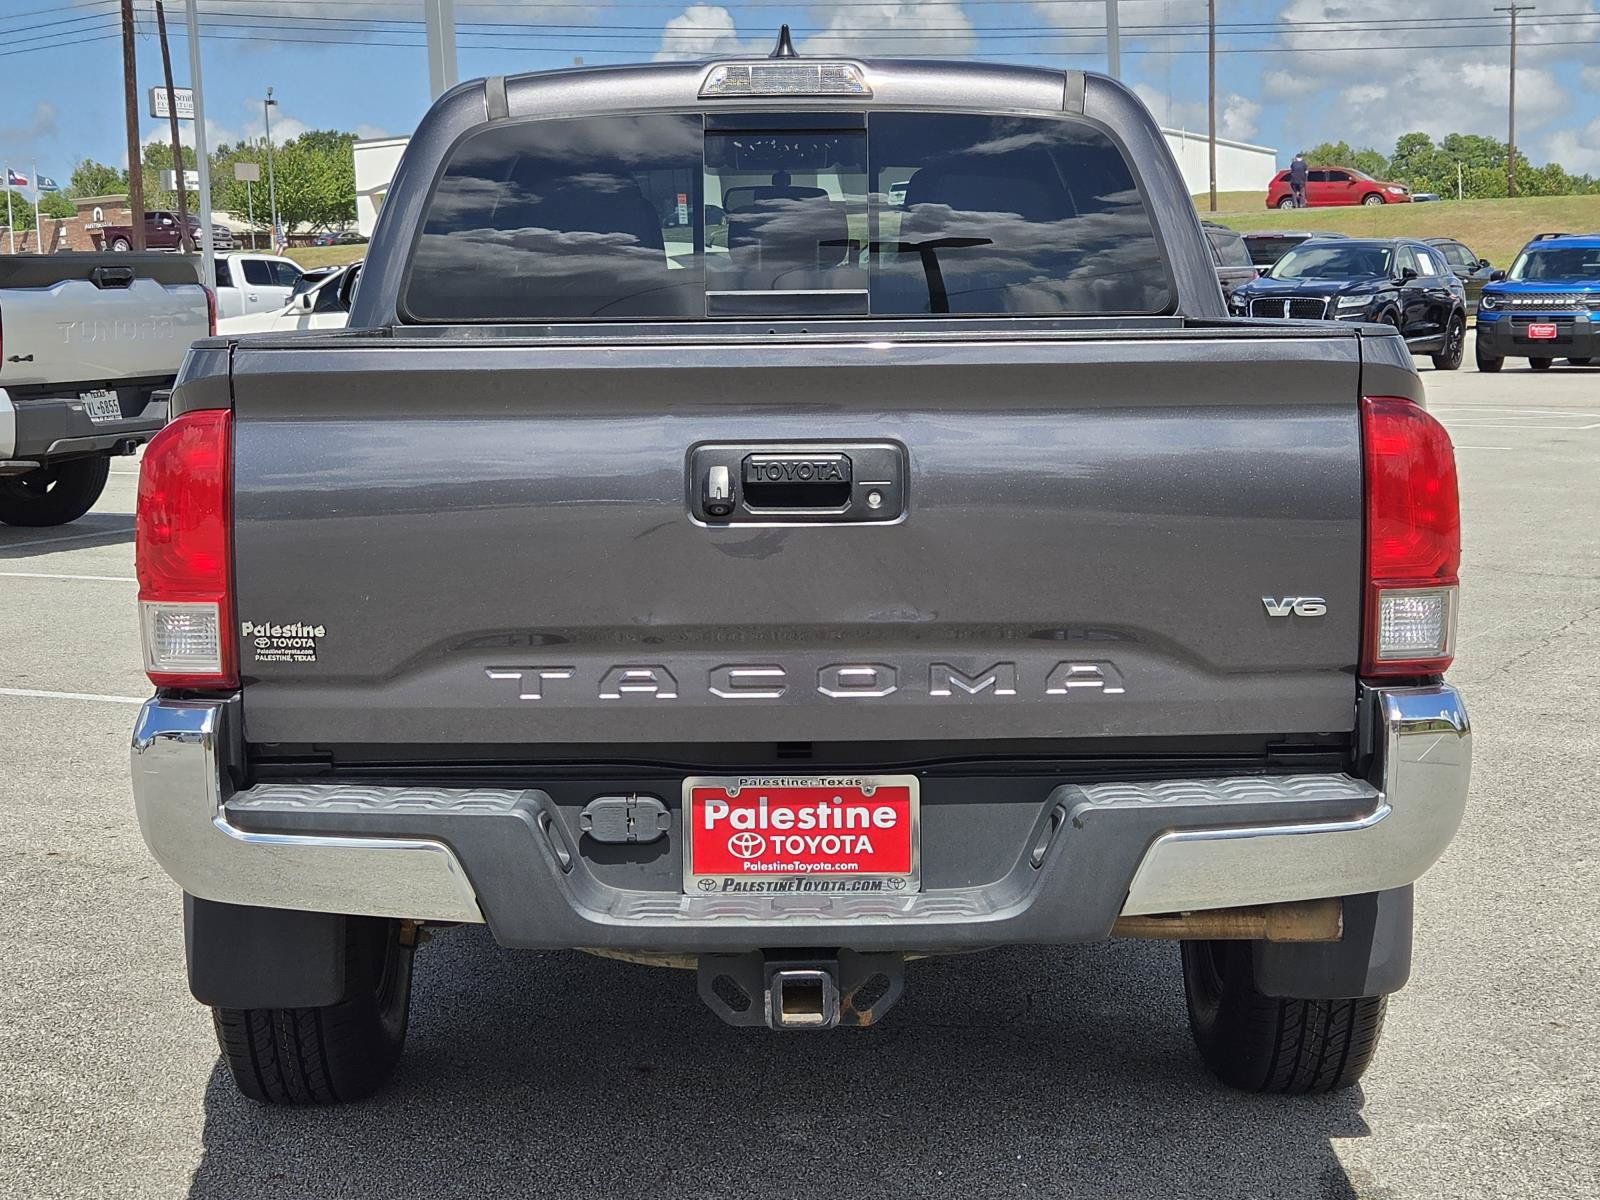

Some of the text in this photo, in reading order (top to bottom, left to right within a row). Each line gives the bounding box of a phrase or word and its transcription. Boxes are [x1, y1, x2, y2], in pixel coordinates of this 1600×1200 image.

[752, 462, 843, 480] TOYOTA
[1262, 597, 1327, 616] V6
[241, 621, 326, 637] Palestine
[271, 638, 315, 648] TOYOTA
[485, 660, 1125, 699] TACOMA
[819, 778, 862, 786] Texas
[704, 796, 897, 830] Palestine
[770, 835, 873, 855] TOYOTA
[743, 861, 858, 872] PalestineToyota.com
